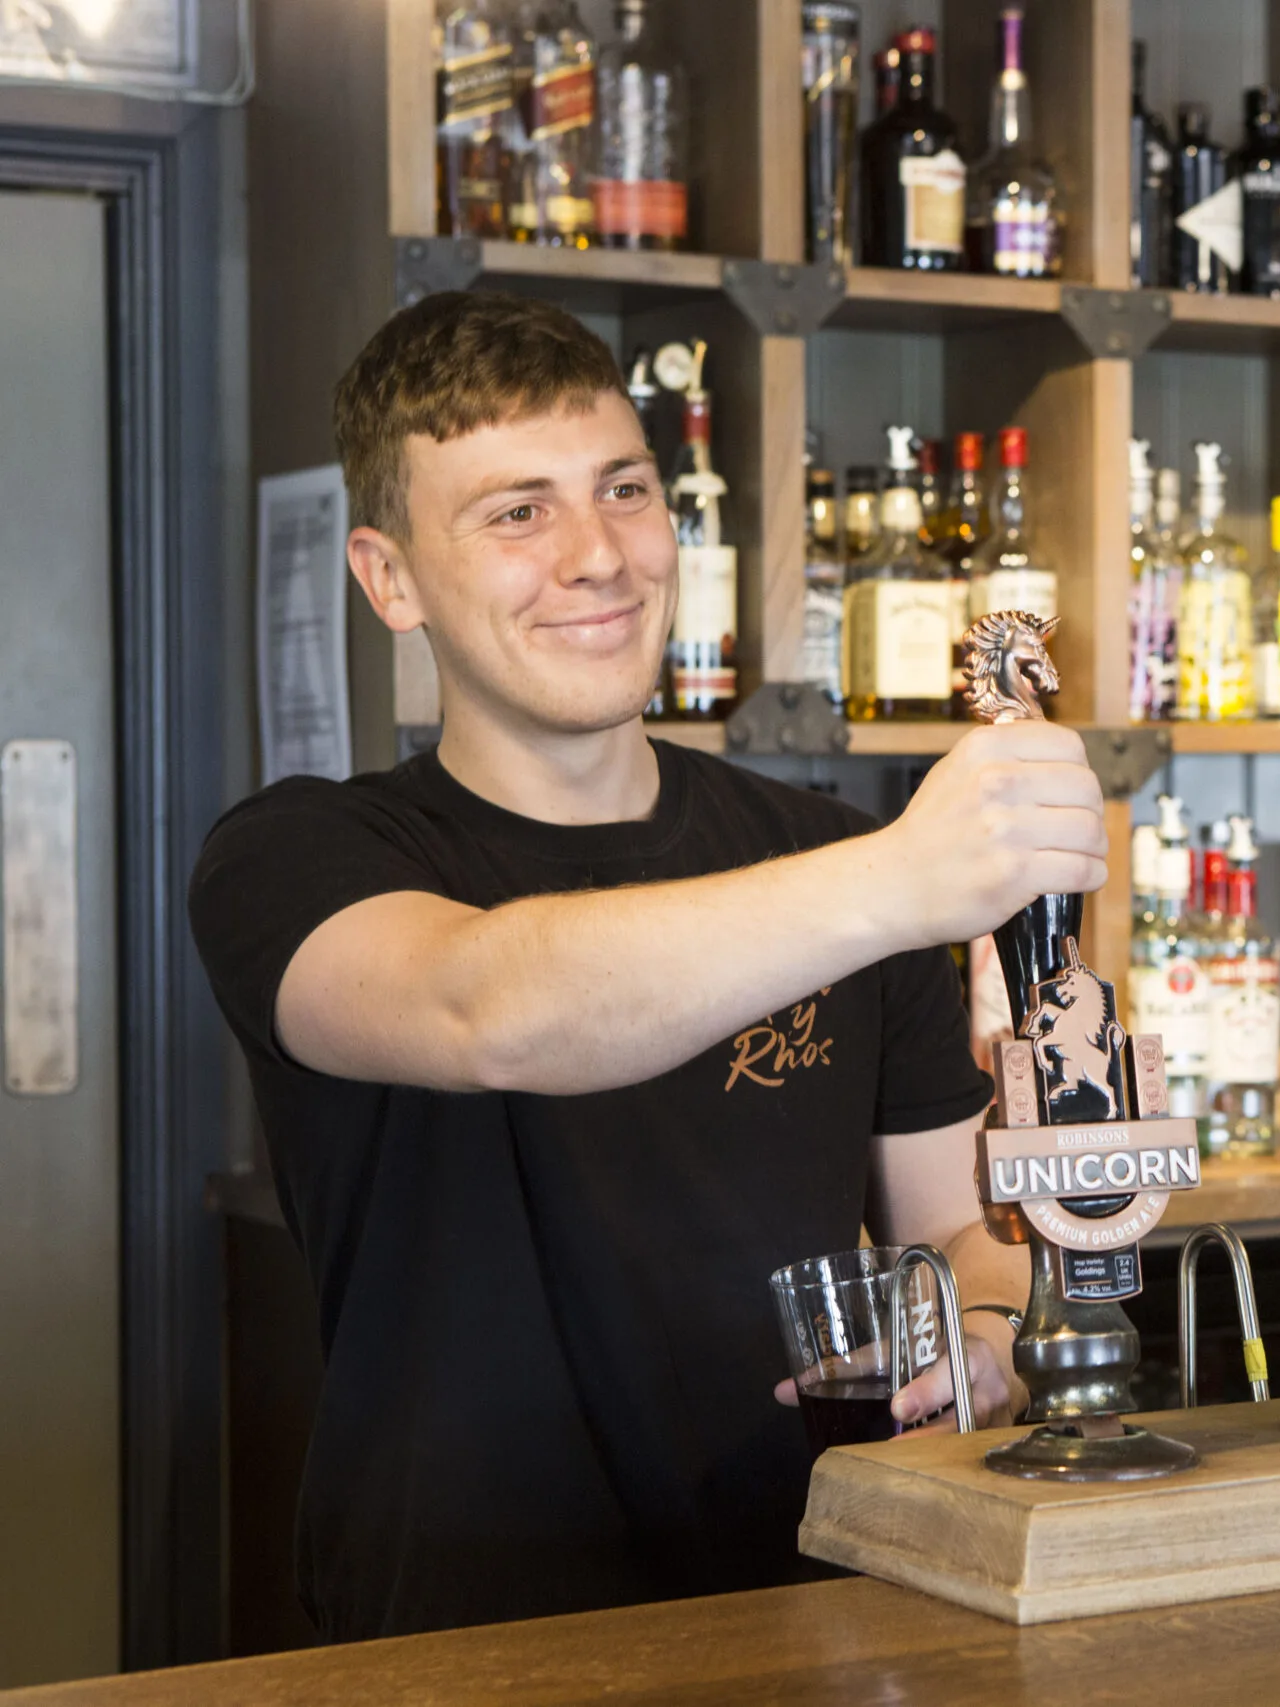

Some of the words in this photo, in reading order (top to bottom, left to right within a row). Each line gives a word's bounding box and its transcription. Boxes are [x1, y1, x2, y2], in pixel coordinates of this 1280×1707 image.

[725, 1026, 833, 1092] Rhos
[1057, 1130, 1128, 1147] ROBINSONS
[995, 1146, 1199, 1195] UNICORN
[1036, 1204, 1088, 1244] PREMIUM
[1092, 1216, 1141, 1246] GOLDEN
[1139, 1195, 1160, 1224] ALE
[1075, 1266, 1107, 1277] Goldings
